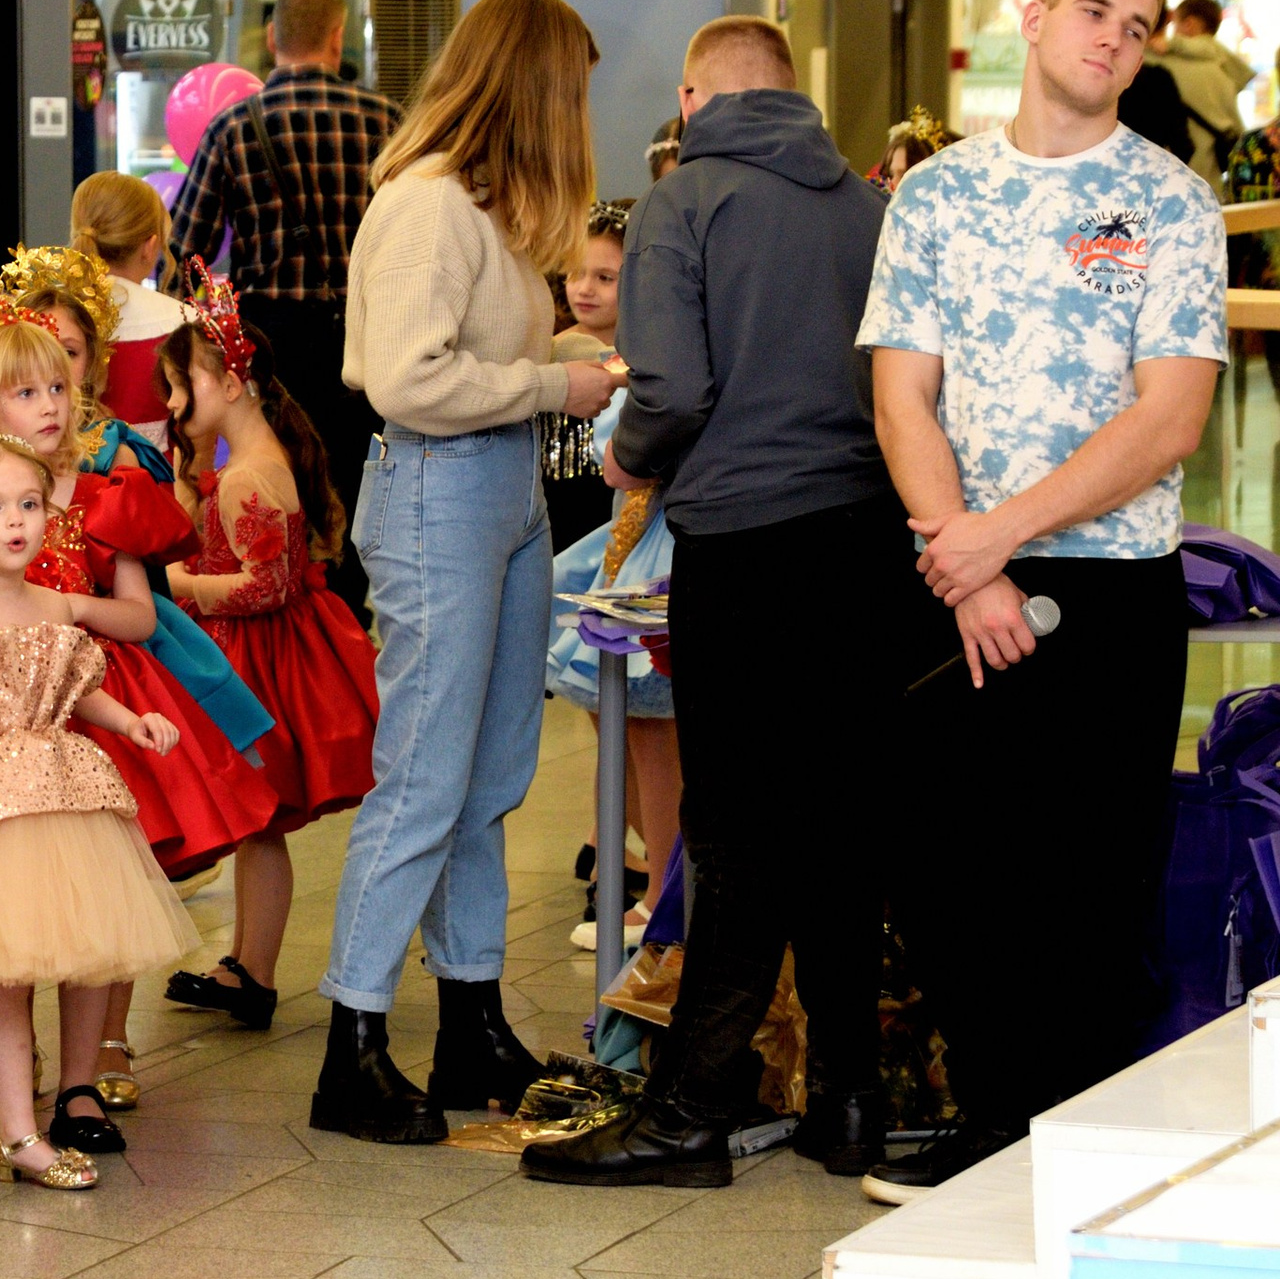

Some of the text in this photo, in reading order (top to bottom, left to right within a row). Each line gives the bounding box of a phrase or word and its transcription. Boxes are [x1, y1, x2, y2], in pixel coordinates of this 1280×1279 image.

[126, 21, 210, 50] EVERVESS
[1078, 210, 1117, 232] CHILL
[1064, 233, 1148, 266] Summe
[1077, 270, 1147, 294] PARADISE
